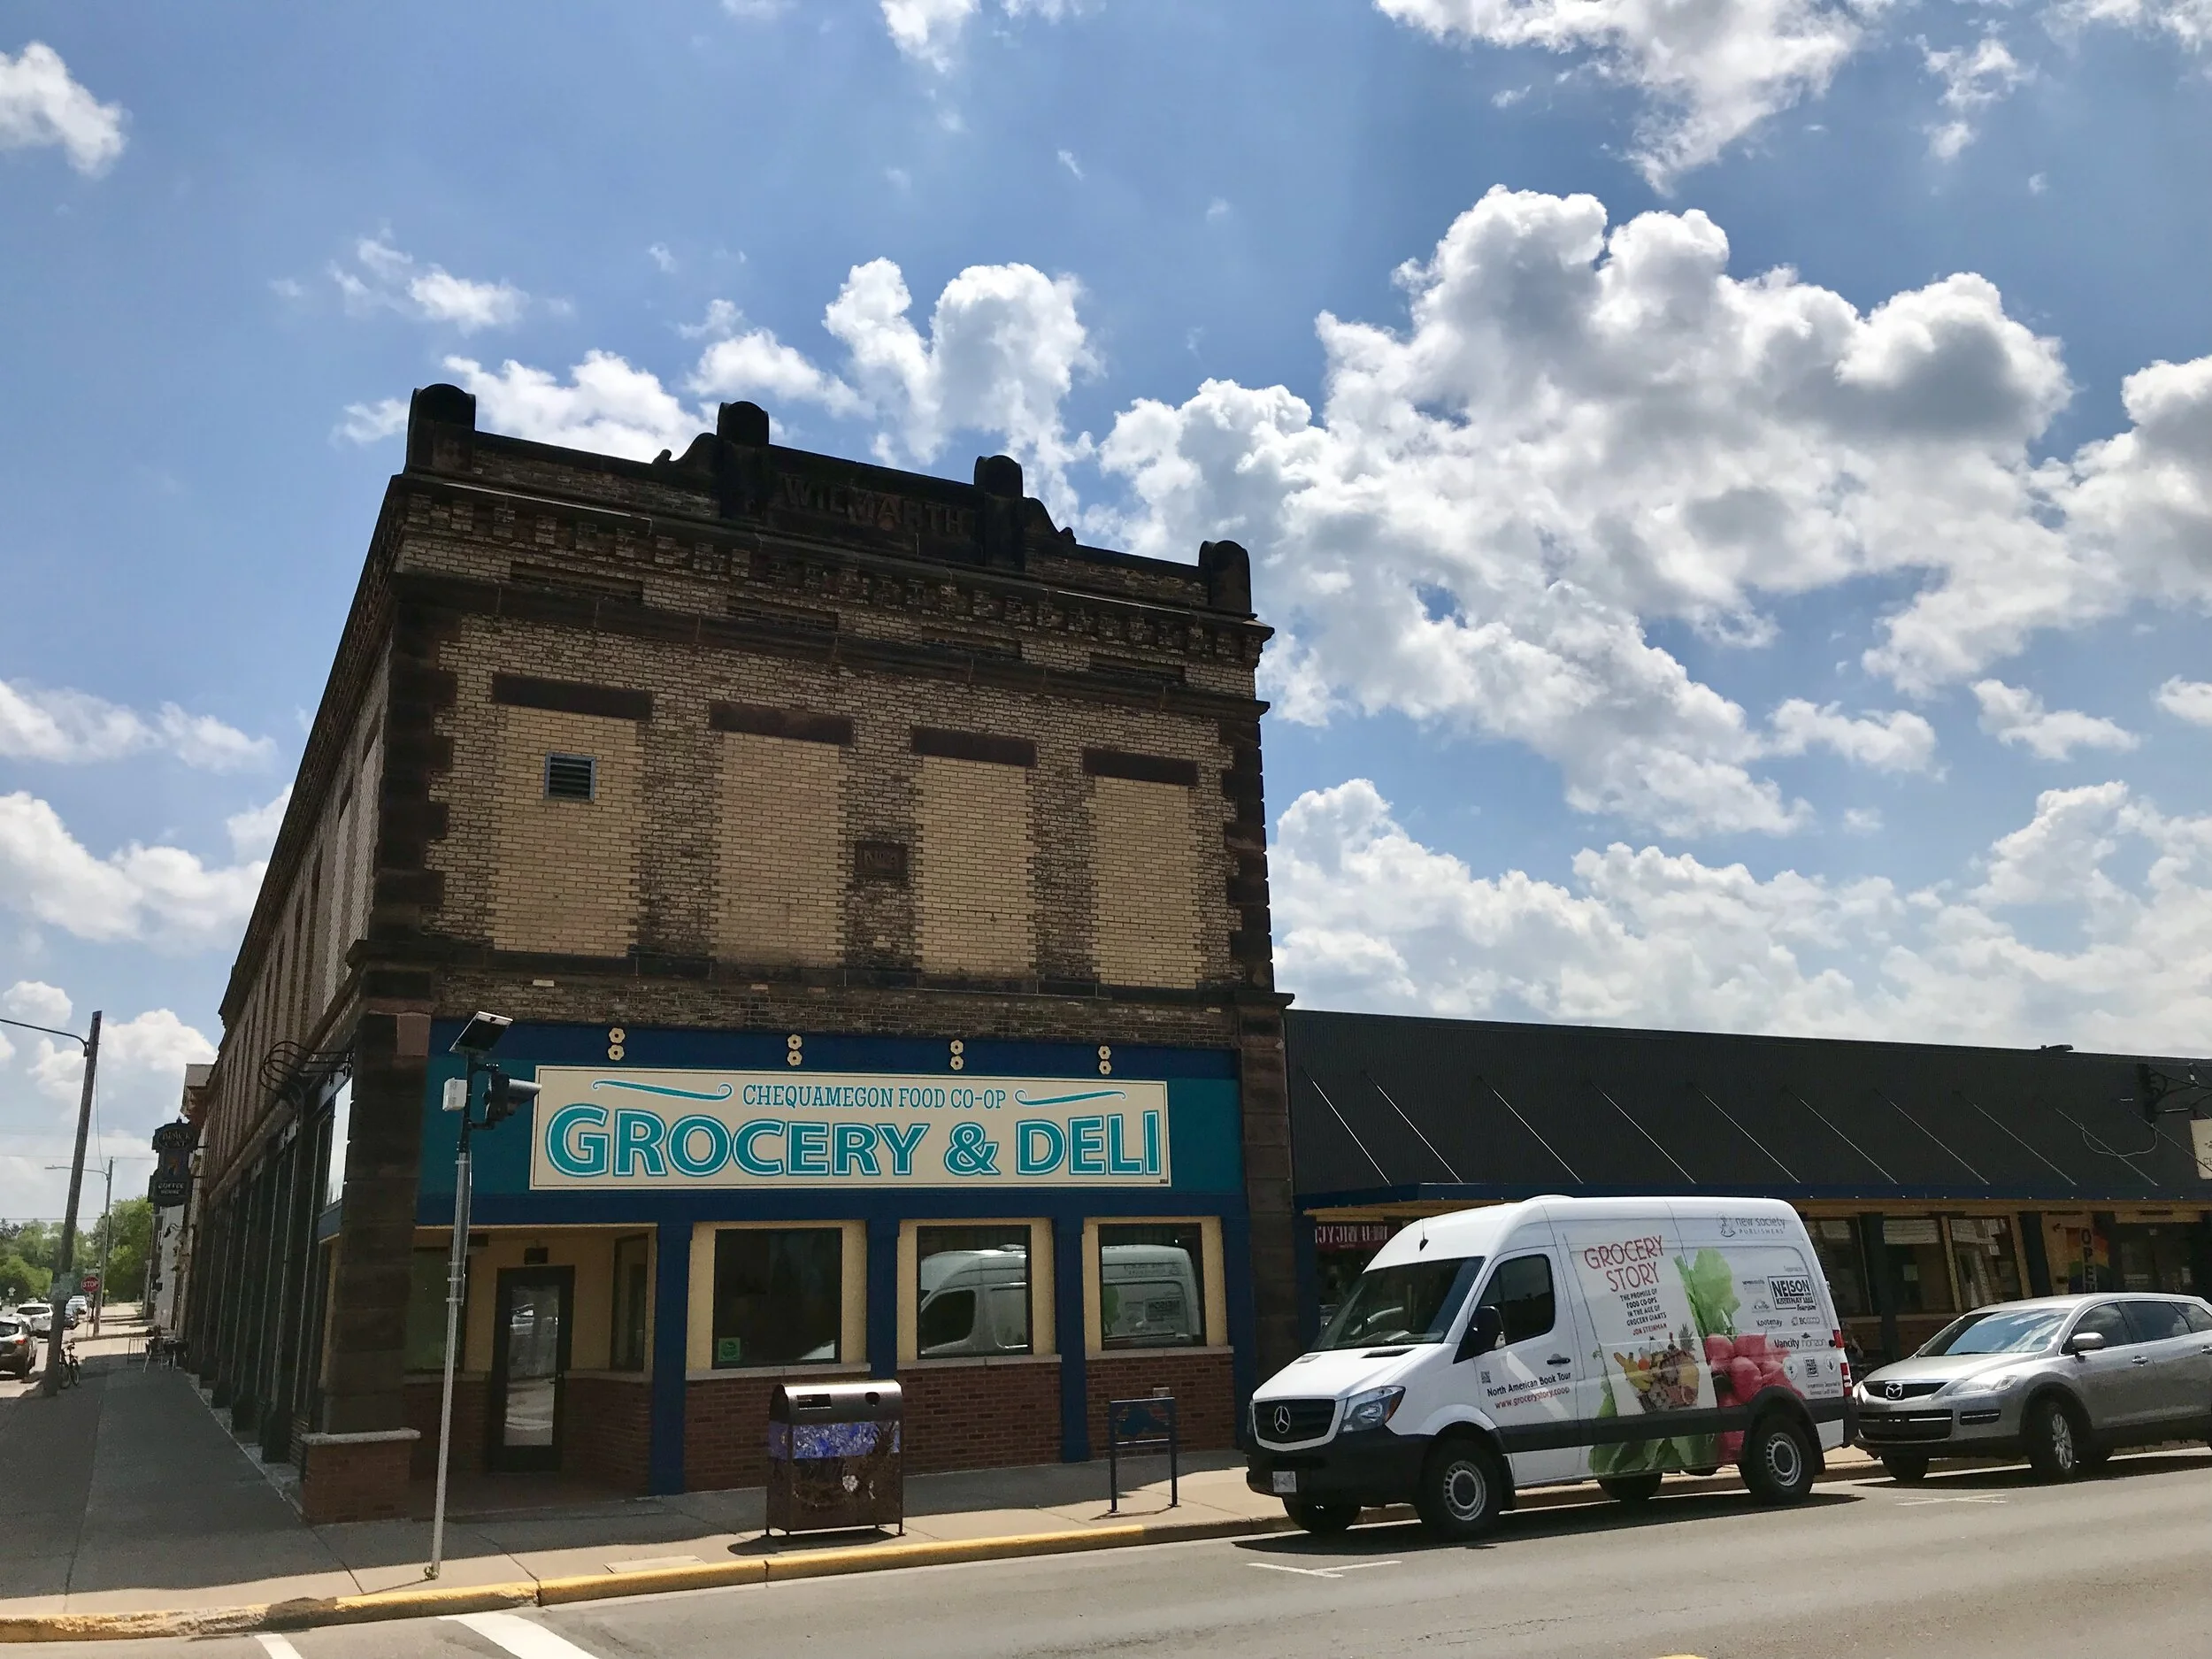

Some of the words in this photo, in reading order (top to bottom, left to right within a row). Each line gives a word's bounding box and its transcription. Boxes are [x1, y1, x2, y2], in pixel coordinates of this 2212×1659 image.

[742, 1084, 894, 1109] CHEQUAMEGON
[898, 1087, 946, 1109] FOOD
[949, 1088, 1007, 1110] CO-OP
[545, 1103, 930, 1178] GROCERY
[944, 1122, 1002, 1176] &
[1016, 1110, 1162, 1176] DELI
[1735, 1217, 1754, 1226] new
[1755, 1217, 1786, 1229] society
[1584, 1235, 1664, 1270] GROCERY
[1605, 1262, 1660, 1293] STORY
[1619, 1294, 1631, 1302] THE
[1771, 1279, 1810, 1298] NELSON
[1626, 1300, 1640, 1310] FOOD
[1640, 1296, 1657, 1307] CO-OPS
[1626, 1316, 1648, 1326] GROCERY
[1774, 1338, 1800, 1349] Vancity
[1486, 1385, 1507, 1397] North
[1508, 1380, 1538, 1393] American
[1539, 1374, 1556, 1386] Book
[1556, 1371, 1571, 1381] Tour
[1494, 1386, 1570, 1409] www.grocerystory.coop
